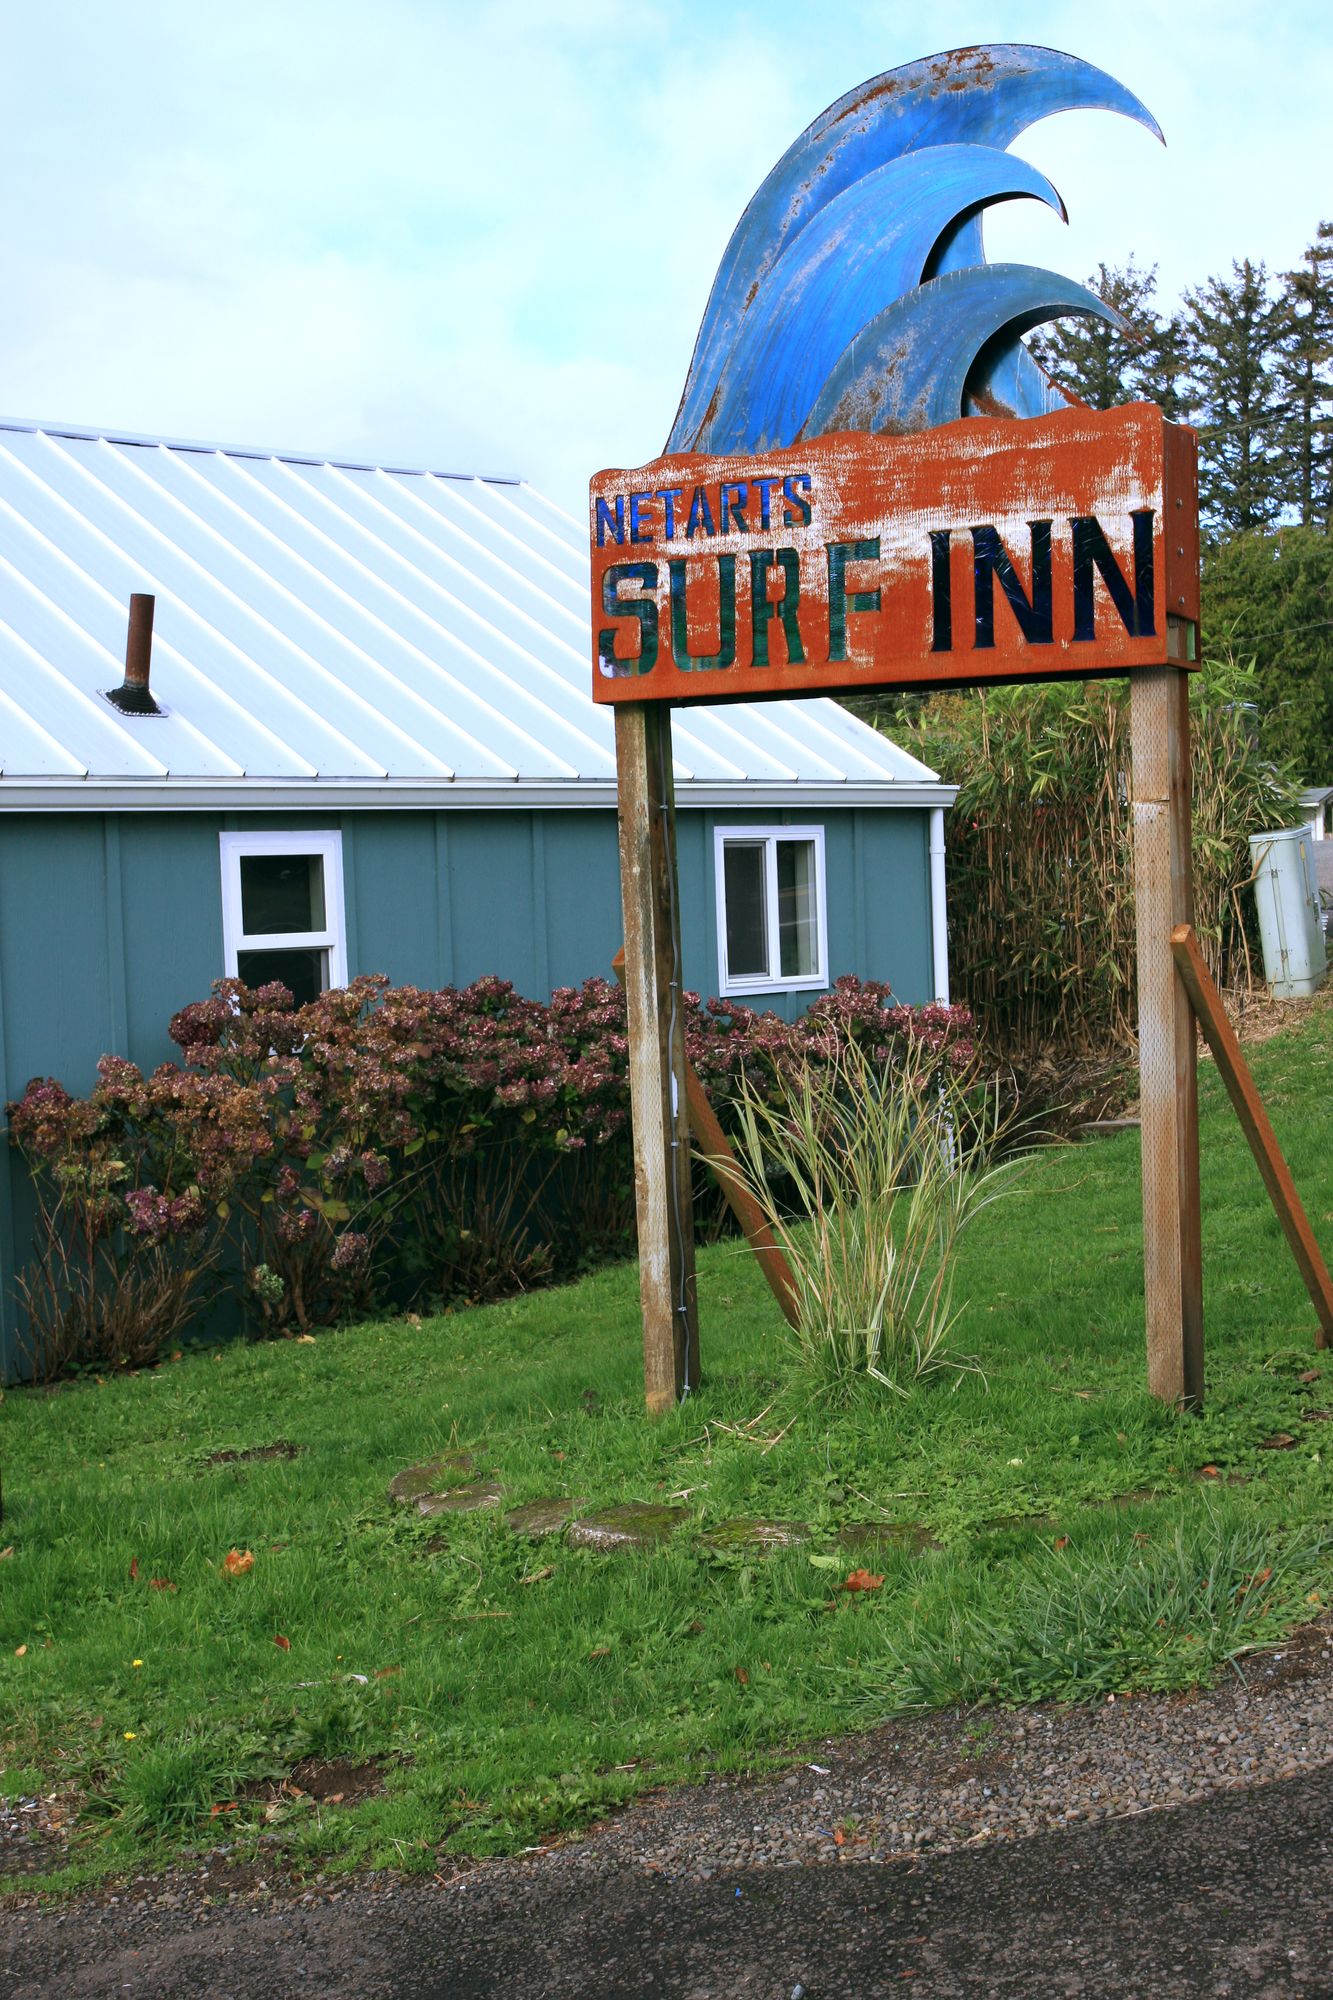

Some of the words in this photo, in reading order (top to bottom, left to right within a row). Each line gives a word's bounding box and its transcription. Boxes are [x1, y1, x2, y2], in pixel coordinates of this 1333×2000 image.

[596, 474, 811, 547] NETARTS
[598, 537, 881, 678] SURF
[929, 509, 1156, 651] INN
